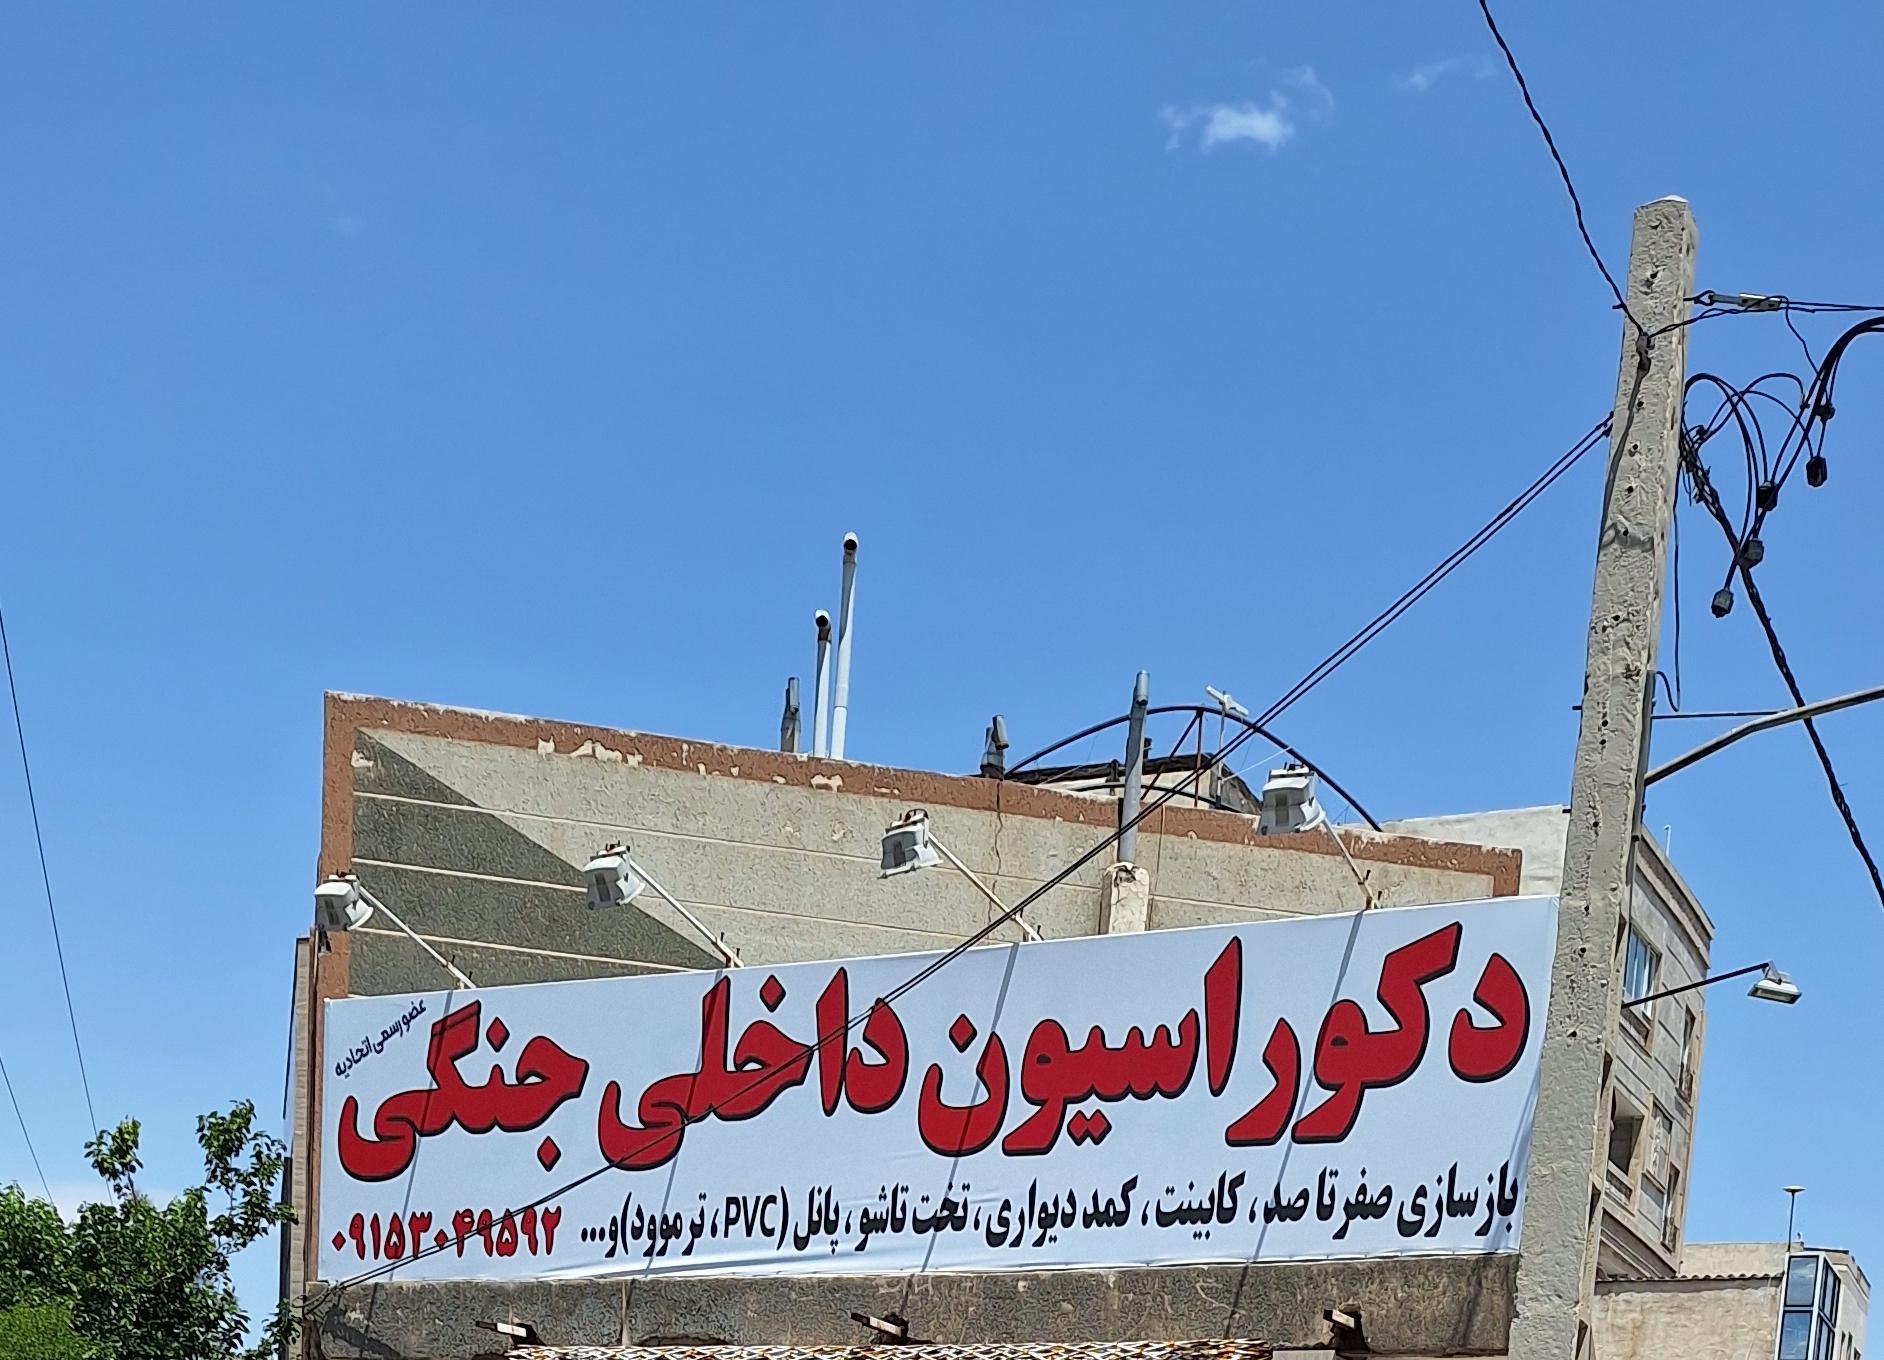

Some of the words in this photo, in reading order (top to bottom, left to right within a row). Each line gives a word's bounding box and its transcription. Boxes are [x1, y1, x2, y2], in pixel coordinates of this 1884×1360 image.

[372, 1019, 404, 1055] رسمی
[401, 999, 427, 1033] عضو
[918, 921, 1531, 1157] دکوراسیون
[335, 1035, 373, 1079] اتحادیه
[598, 967, 910, 1171] داخلی
[338, 1000, 590, 1182] جنگی
[793, 1184, 840, 1256] پانل
[912, 1181, 971, 1235] تخت
[1082, 1174, 1139, 1229] کمد
[1315, 1165, 1339, 1221] تا
[1332, 1166, 1394, 1240] صفر
[331, 1205, 562, 1260] ۰۹۱۵۳۰۴۹۵۹۲
